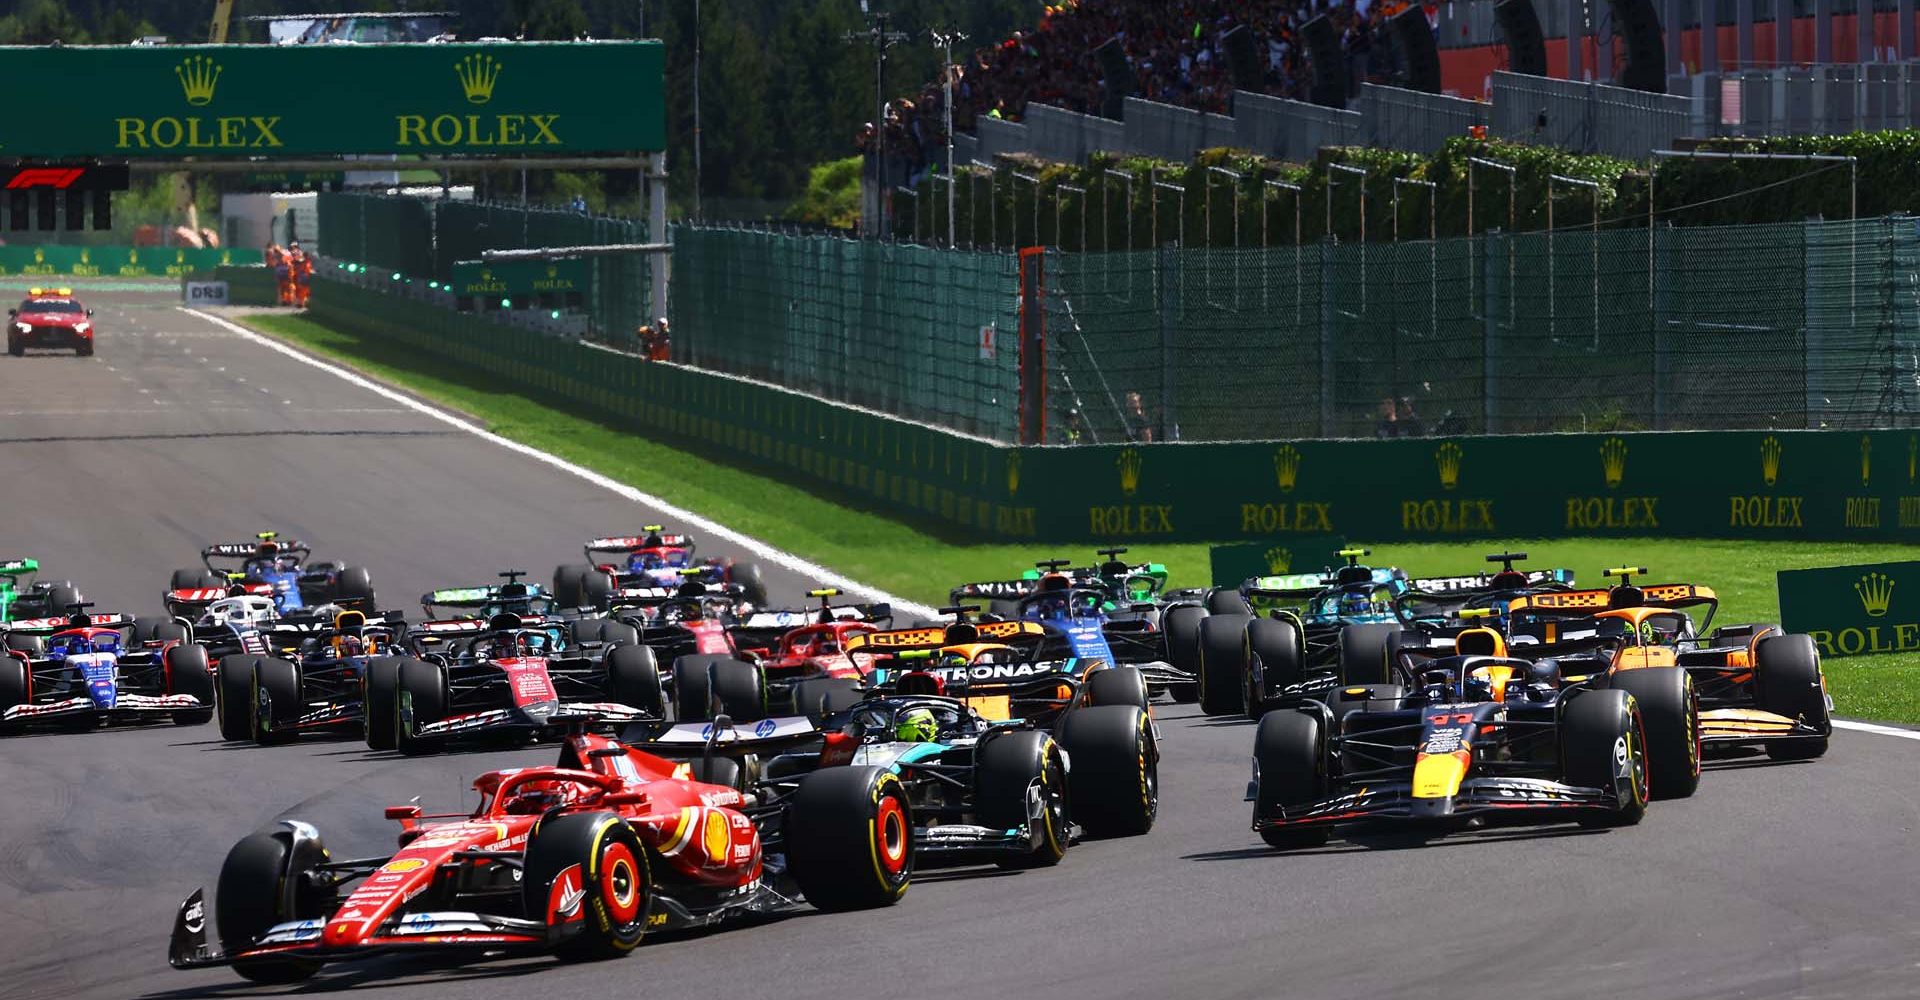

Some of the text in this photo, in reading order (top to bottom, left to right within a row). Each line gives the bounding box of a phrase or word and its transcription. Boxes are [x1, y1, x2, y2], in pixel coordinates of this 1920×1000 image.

[115, 117, 283, 148] ROLEX
[397, 114, 562, 146] ROLEX
[192, 286, 224, 299] DRS
[1090, 505, 1174, 534] ROLEX
[1241, 502, 1334, 532] ROLEX
[1402, 499, 1496, 531] ROLEX
[1566, 497, 1660, 529] ROLEX
[1730, 496, 1803, 528] ROLEX
[901, 660, 1051, 684] TRONAS
[756, 719, 776, 737] hp
